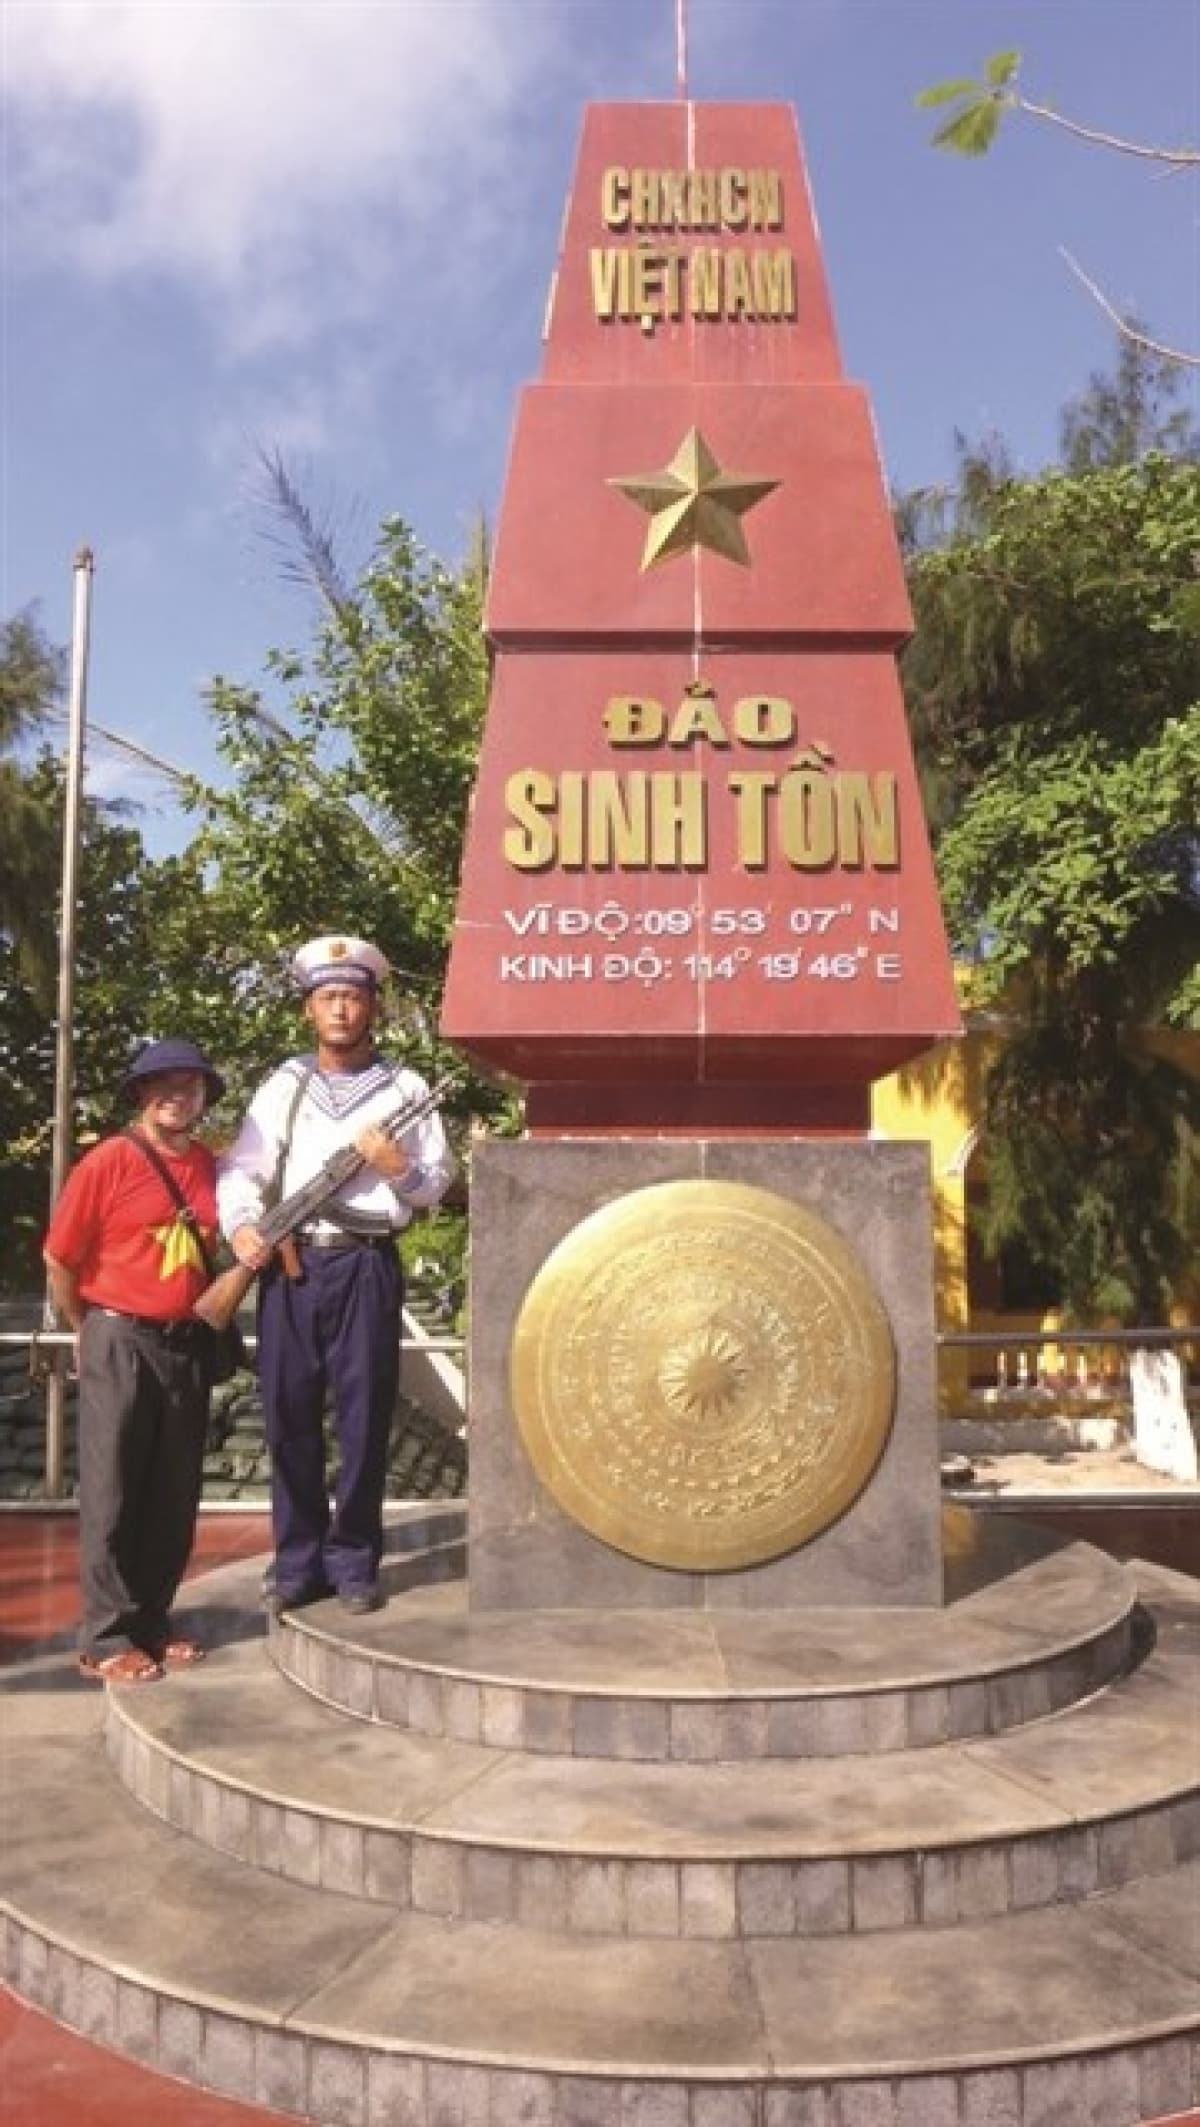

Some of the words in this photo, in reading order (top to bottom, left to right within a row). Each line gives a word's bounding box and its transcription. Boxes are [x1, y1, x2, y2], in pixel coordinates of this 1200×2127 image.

[602, 166, 782, 232] CHXHCN
[590, 239, 688, 337] VIỆT
[690, 247, 798, 322] NAM
[602, 678, 798, 750] ĐẢO
[503, 767, 709, 874] SINH
[727, 740, 902, 874] TỒN
[504, 903, 553, 935] VĨ
[868, 908, 899, 933] N
[501, 954, 593, 981] KINH
[601, 946, 673, 989] ĐỘ:
[875, 954, 901, 979] E
